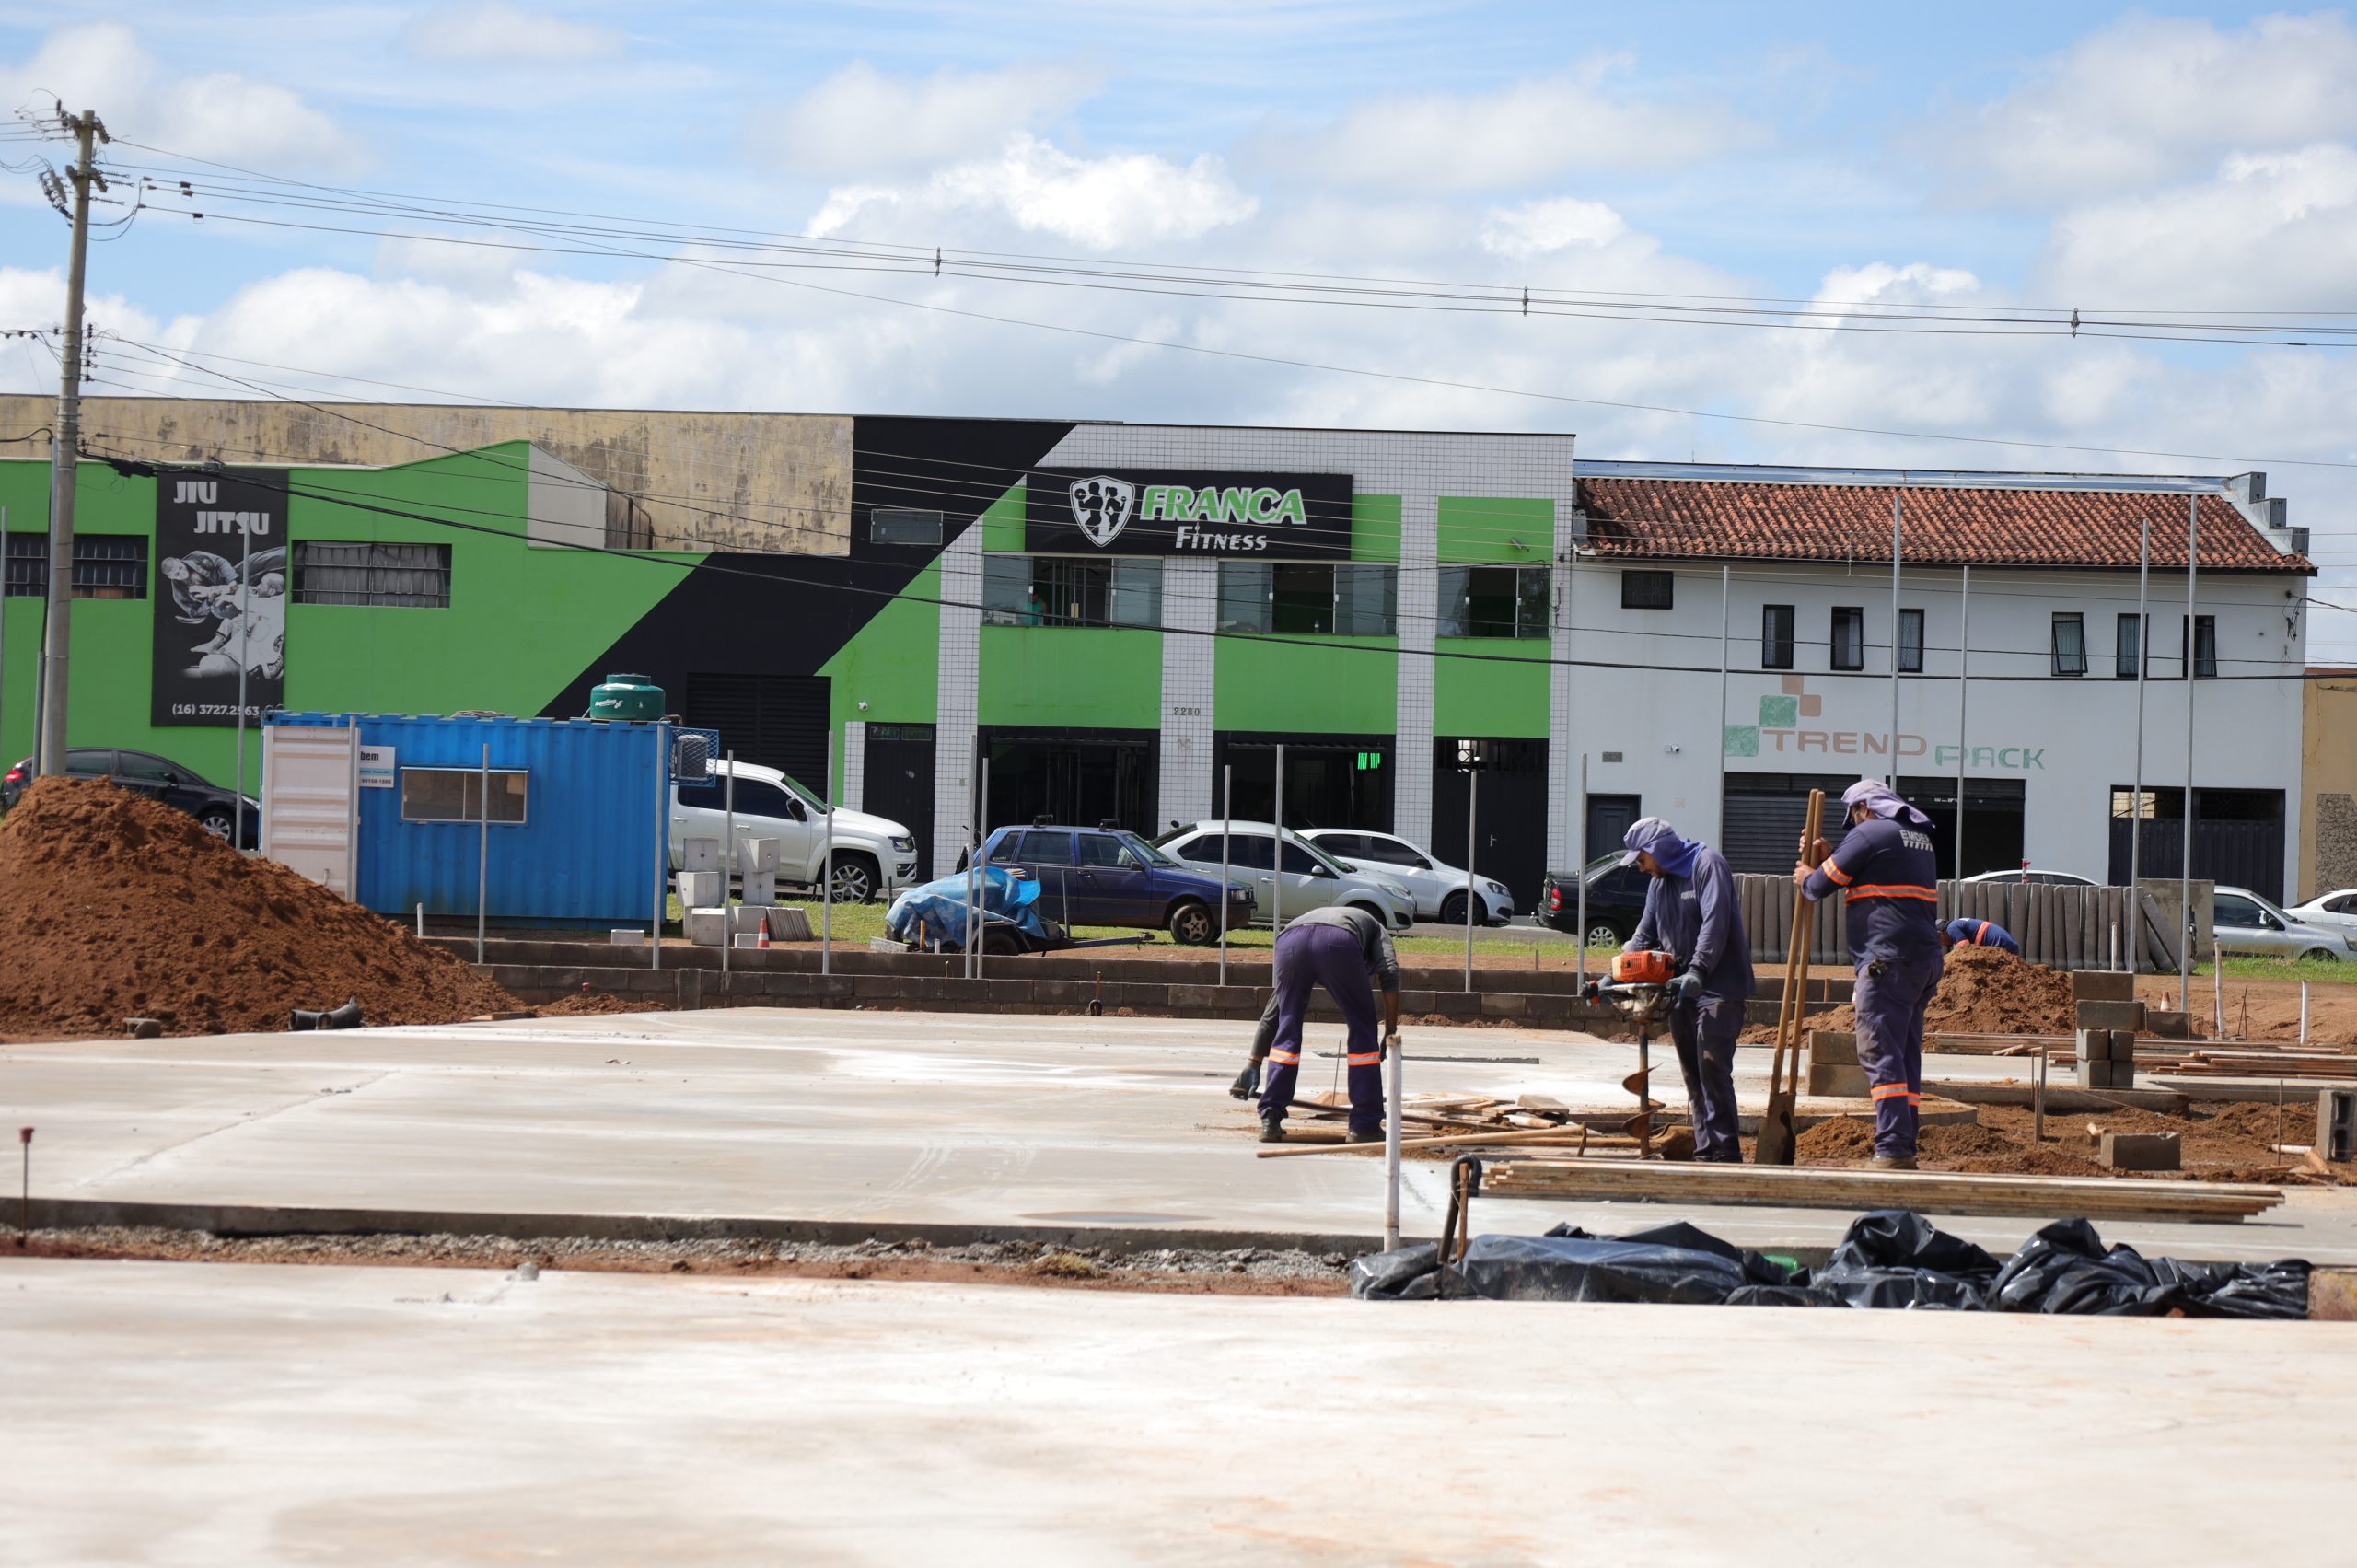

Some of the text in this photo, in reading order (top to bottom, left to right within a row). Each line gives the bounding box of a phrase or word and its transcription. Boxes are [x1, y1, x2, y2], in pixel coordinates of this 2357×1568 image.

[173, 481, 217, 504] JIU
[1140, 484, 1307, 525] FRANCA
[193, 511, 270, 535] JITSU
[172, 703, 196, 715] (16)
[1174, 707, 1200, 716] 2280
[1762, 729, 2045, 770] TREND PACK
